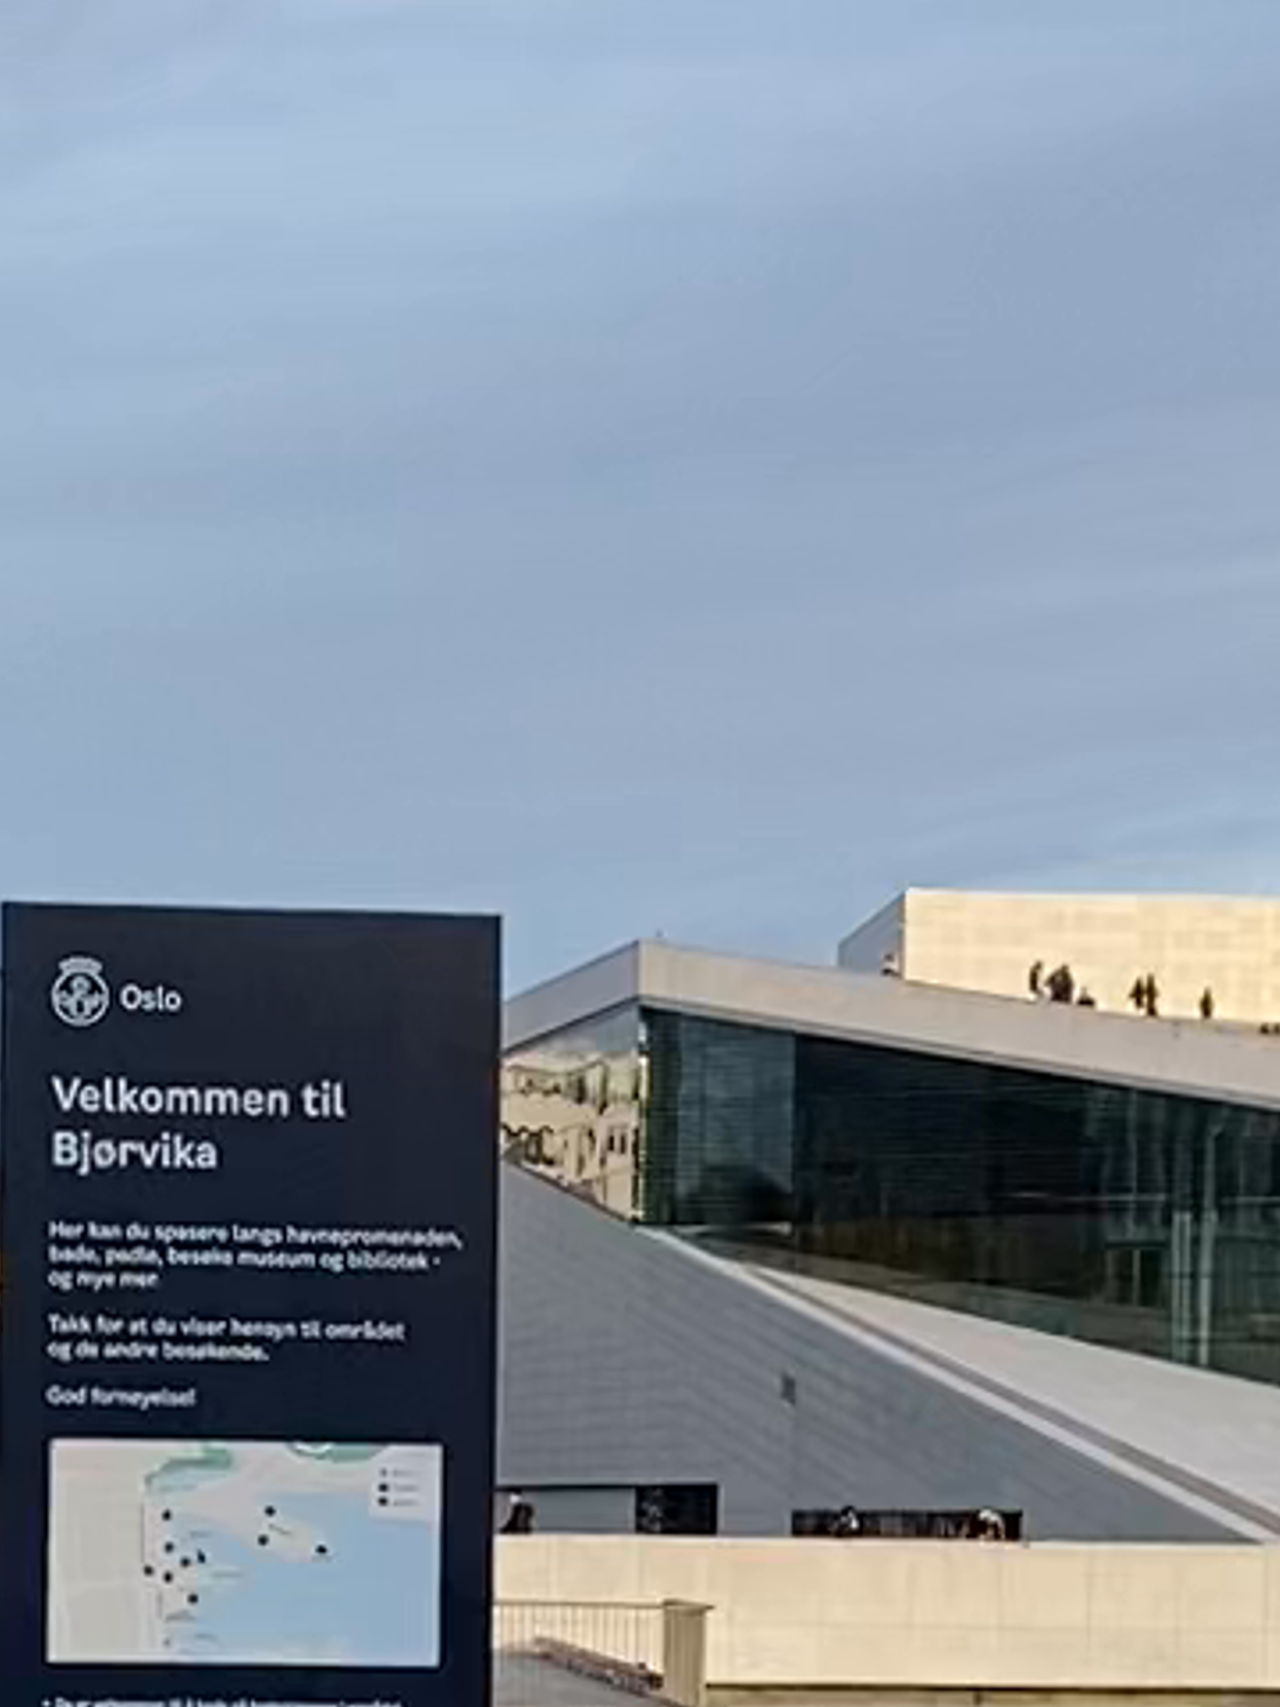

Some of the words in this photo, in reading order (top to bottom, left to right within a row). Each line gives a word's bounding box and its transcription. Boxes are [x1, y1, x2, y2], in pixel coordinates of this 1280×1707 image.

[120, 983, 182, 1012] Oslo
[51, 1075, 289, 1117] Velkommen
[301, 1080, 346, 1118] til
[52, 1129, 217, 1177] Bjørvika
[49, 1222, 84, 1239] Her
[88, 1222, 122, 1239] kan
[125, 1222, 150, 1240] du
[154, 1225, 229, 1244] spasere
[232, 1225, 283, 1246] langs
[237, 1250, 316, 1268] museum
[319, 1251, 344, 1273] og
[347, 1250, 429, 1271] bibliotek
[47, 1271, 73, 1291] og
[76, 1271, 116, 1292] mye
[48, 1314, 91, 1334] Takk
[45, 1384, 87, 1406] God
